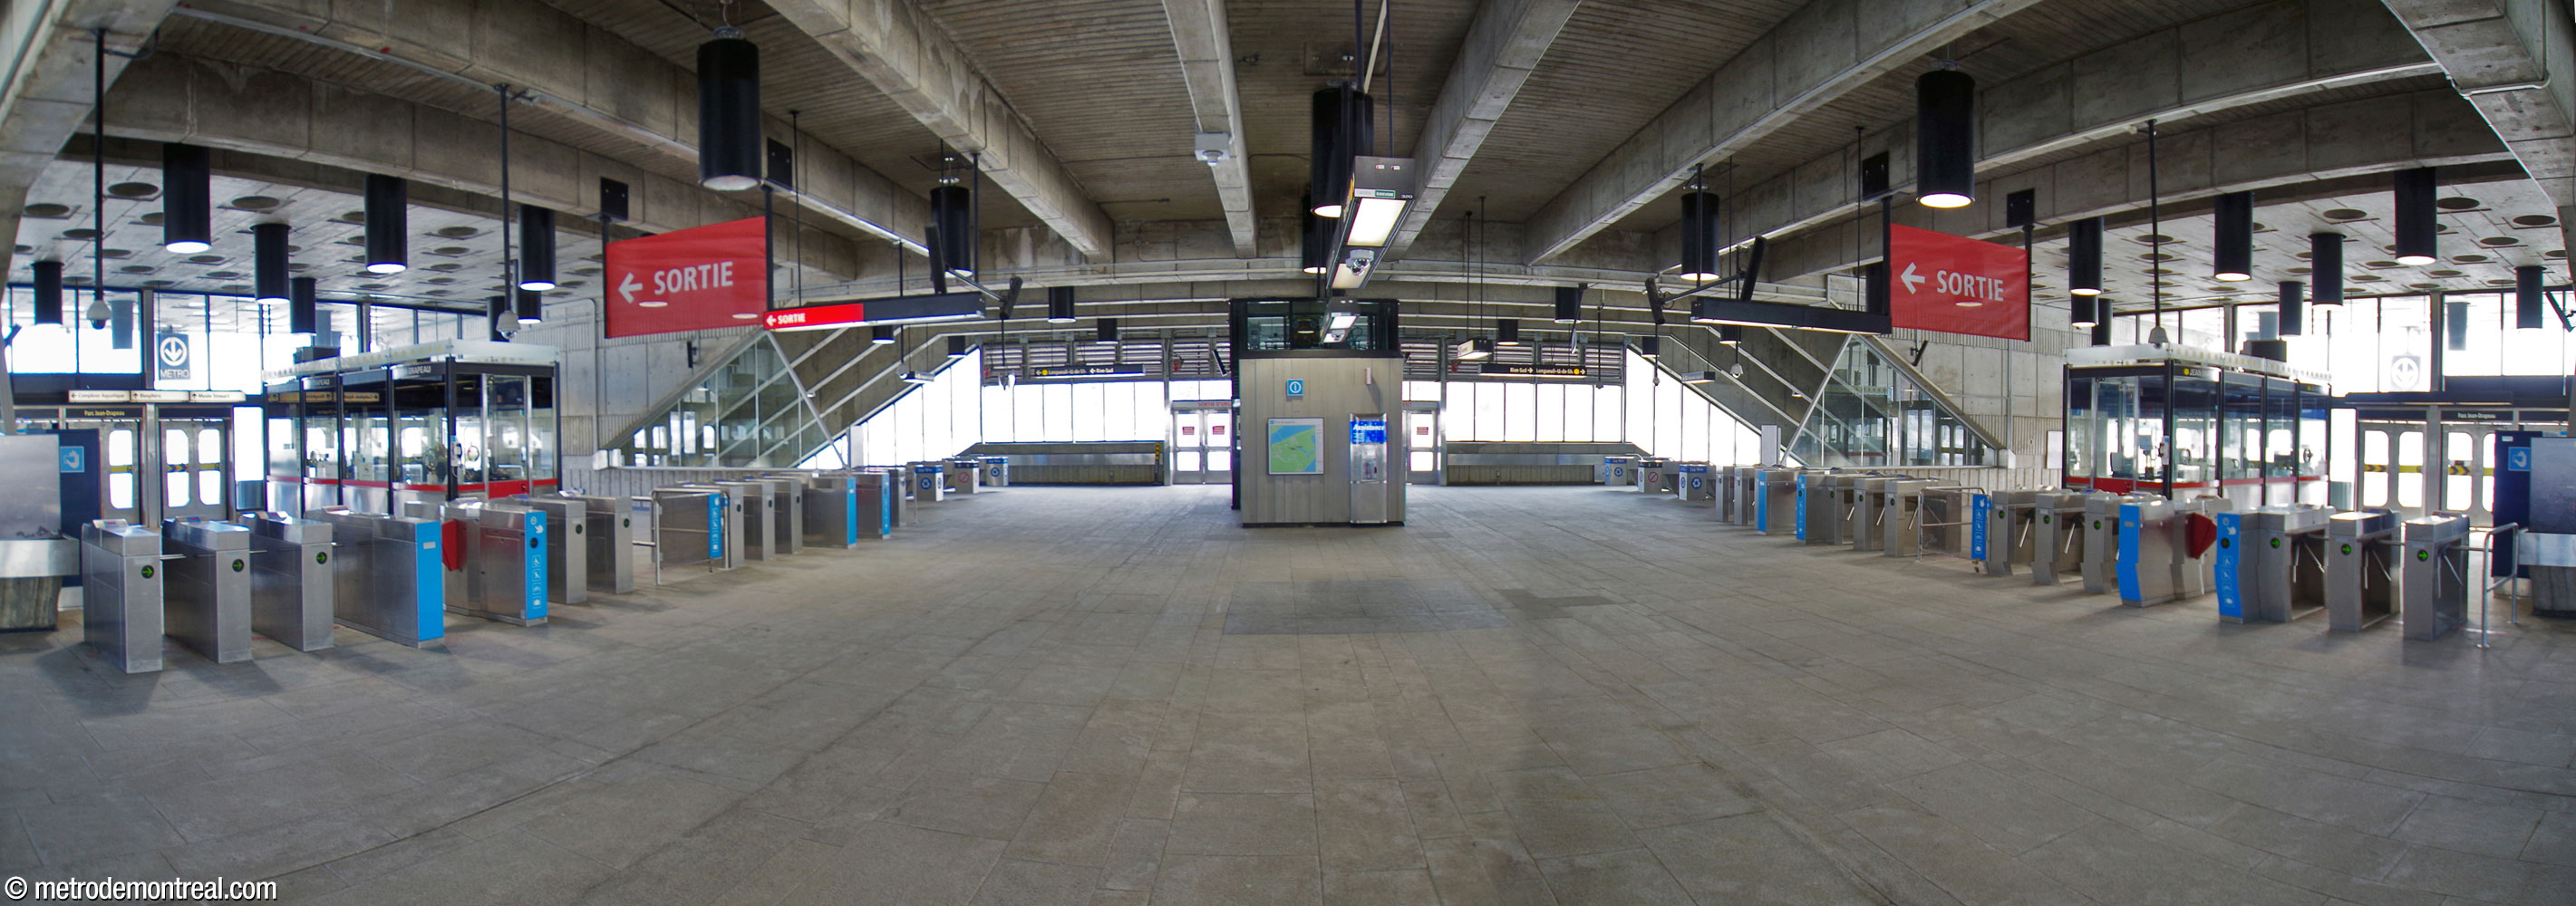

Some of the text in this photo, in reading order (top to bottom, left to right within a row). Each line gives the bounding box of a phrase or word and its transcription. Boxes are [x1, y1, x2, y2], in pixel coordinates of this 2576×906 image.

[654, 261, 734, 295] SORTIE
[1936, 270, 2004, 302] SORTIE
[777, 313, 806, 325] SORTIE
[1352, 423, 1386, 431] Assistance
